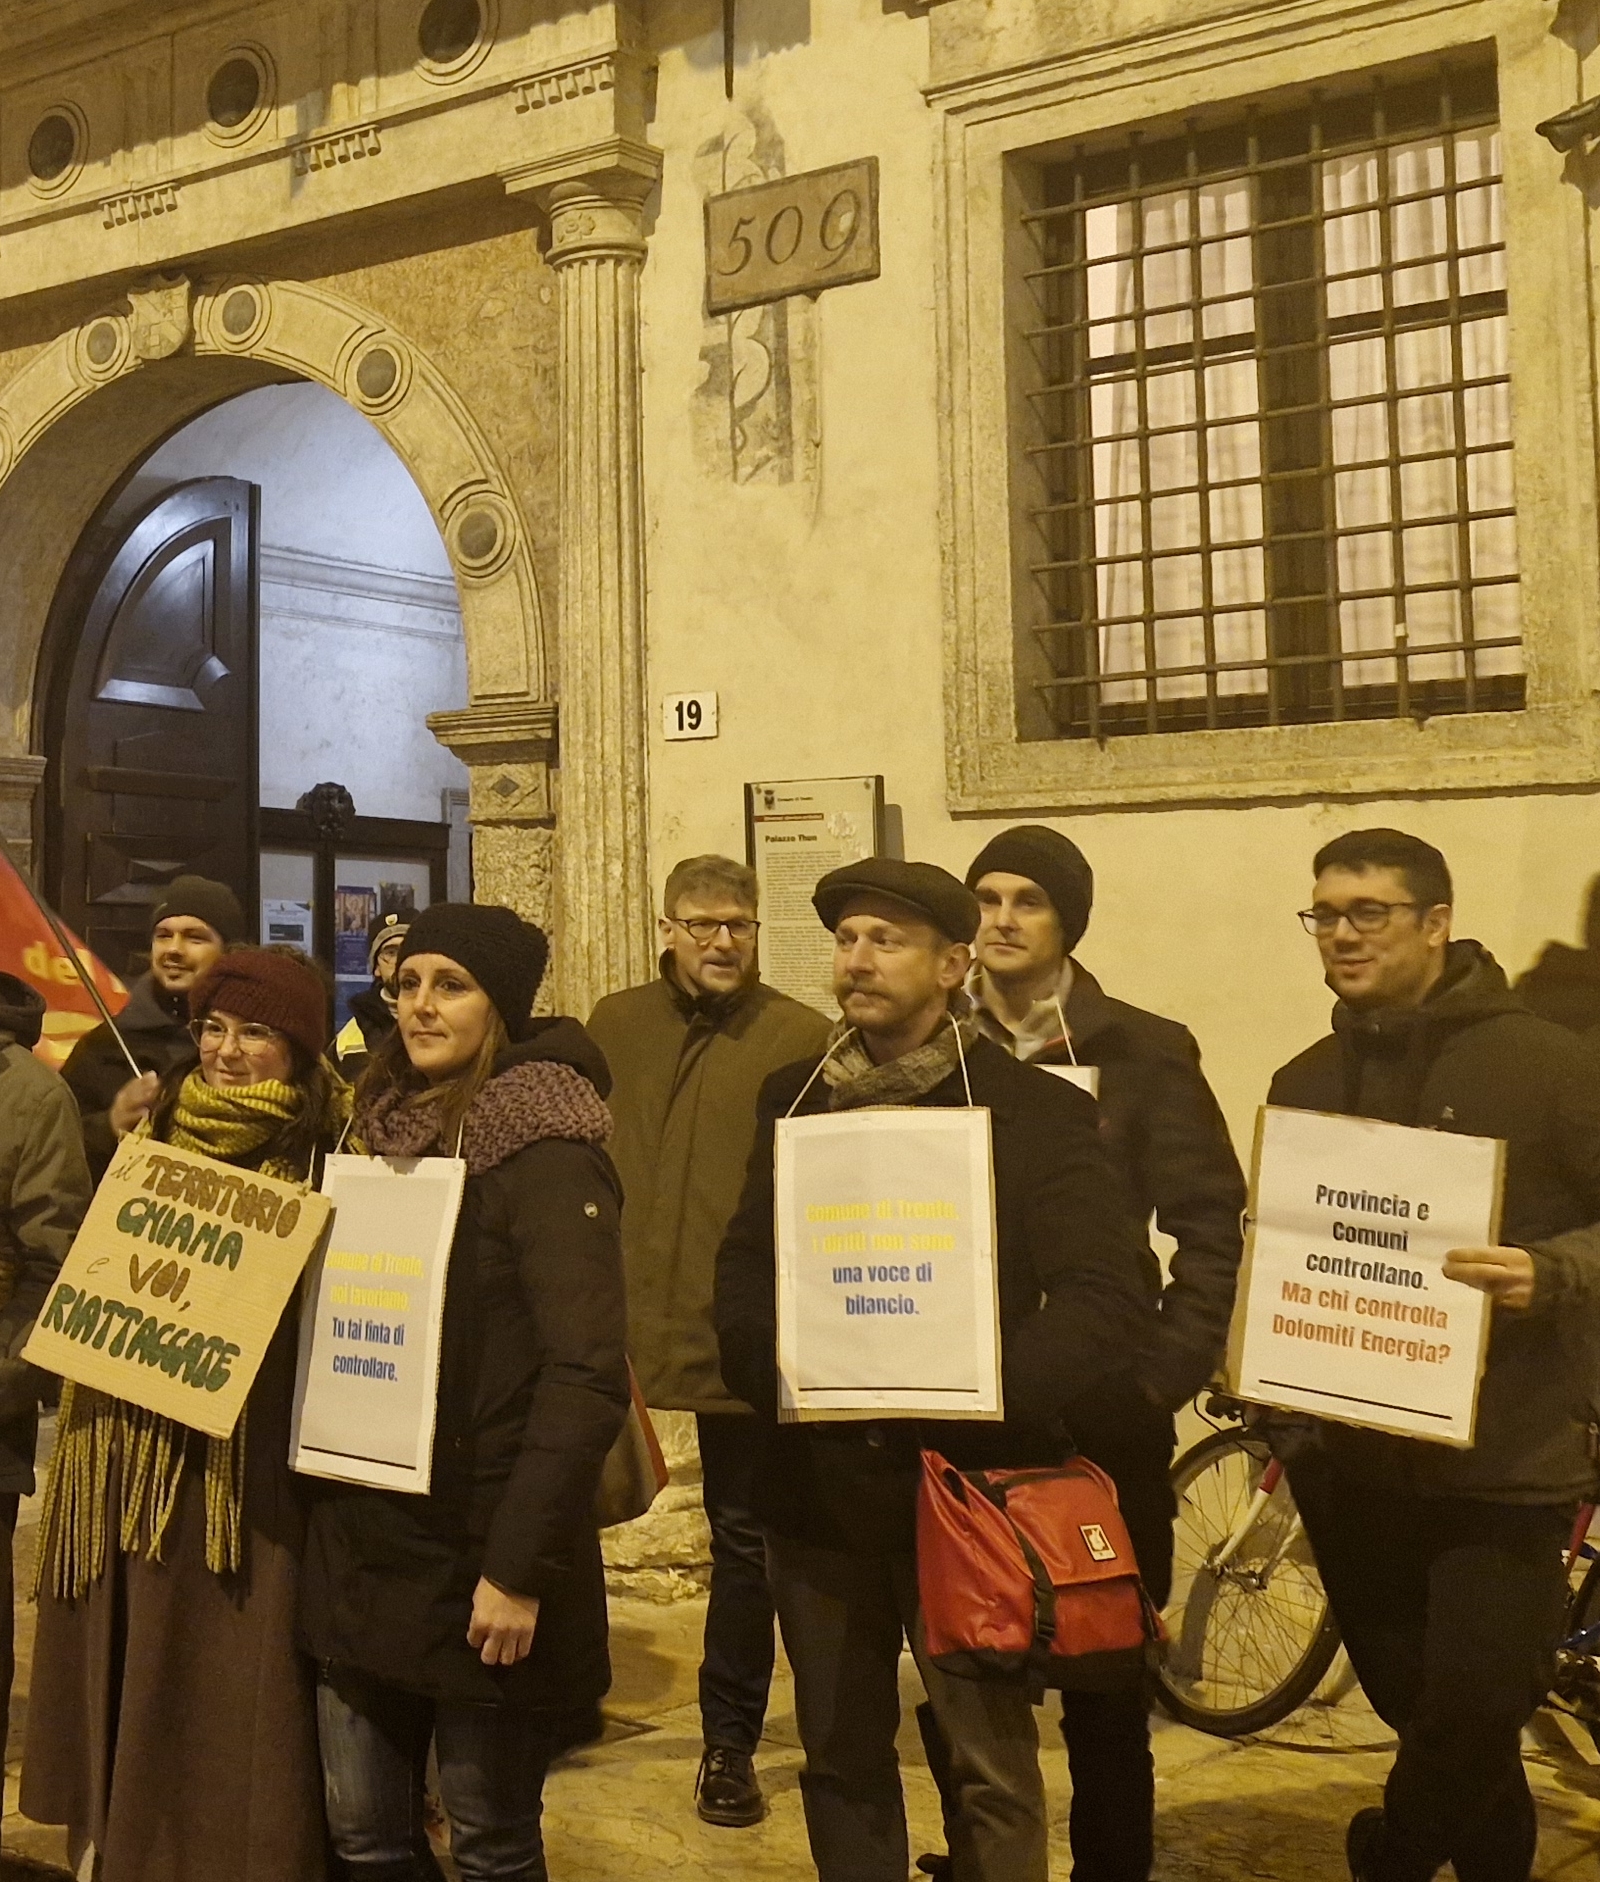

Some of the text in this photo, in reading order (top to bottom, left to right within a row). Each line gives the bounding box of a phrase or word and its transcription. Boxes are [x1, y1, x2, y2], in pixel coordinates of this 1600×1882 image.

[718, 189, 861, 276] 509
[675, 699, 702, 731] 19
[765, 835, 796, 843] Palazzo
[142, 1154, 302, 1238] TERRITORIO
[804, 1203, 871, 1222] Comune
[875, 1198, 892, 1220] di
[1315, 1184, 1430, 1221] Provincia e
[116, 1197, 244, 1272] CHIAMA
[871, 1234, 904, 1251] non
[909, 1234, 955, 1252] sono
[1332, 1221, 1408, 1252] Comuni
[128, 1253, 191, 1312] VOI,
[833, 1262, 933, 1284] una voce di
[1306, 1253, 1429, 1291] controllano.
[846, 1294, 920, 1315] bilancio.
[1281, 1281, 1448, 1330] Ma chi controlla
[41, 1283, 241, 1392] RIATTACCATE
[332, 1317, 405, 1346] Tu fai finta di
[1272, 1314, 1451, 1364] Dolomiti Energia?
[332, 1354, 398, 1382] controllare.
